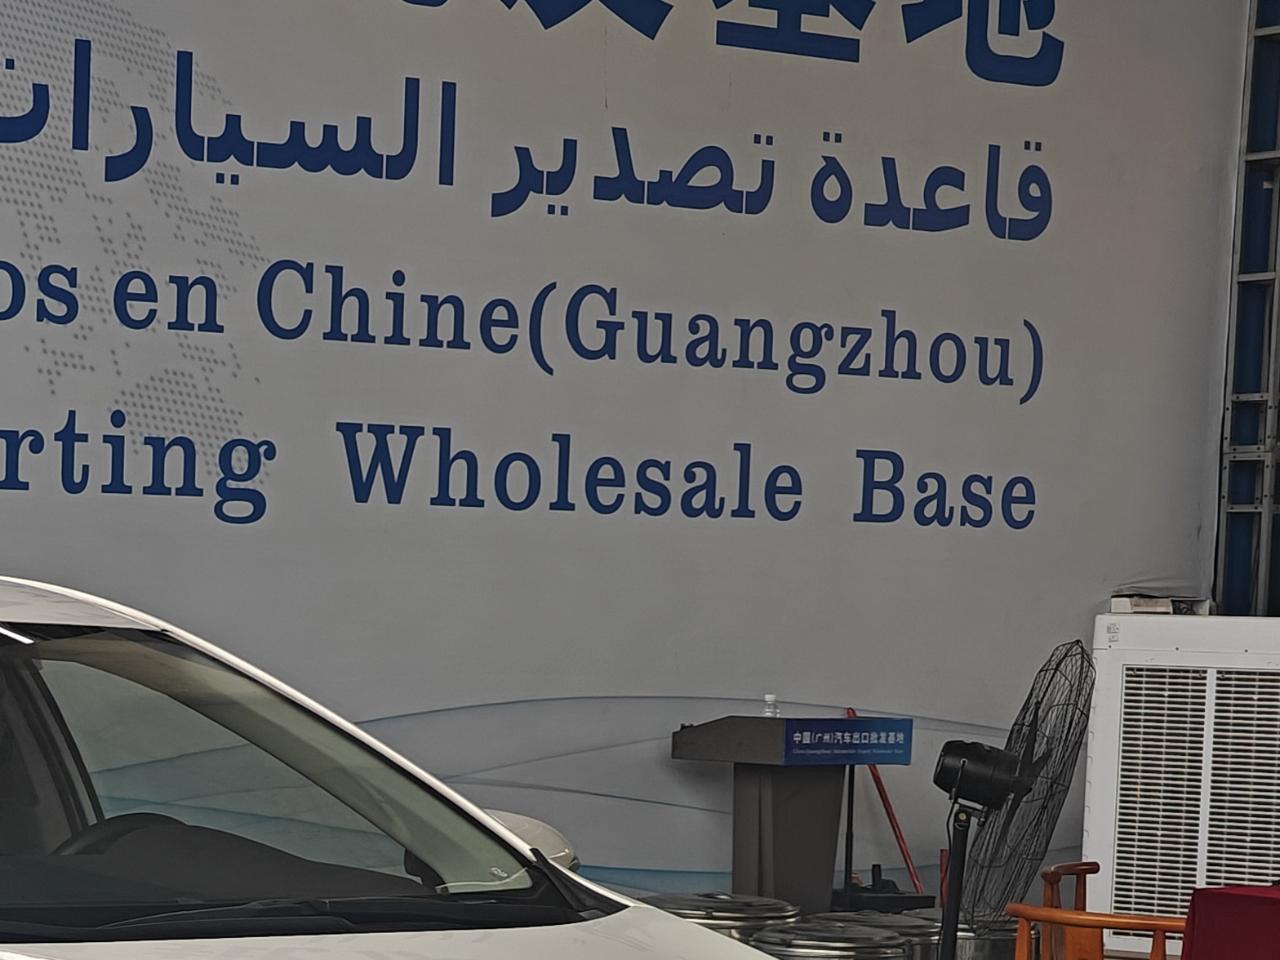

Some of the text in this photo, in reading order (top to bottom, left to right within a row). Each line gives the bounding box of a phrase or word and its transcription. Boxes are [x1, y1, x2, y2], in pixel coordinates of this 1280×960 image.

[491, 126, 776, 218] تصدير
[810, 132, 1055, 242] قاعدة
[113, 265, 225, 335] en
[256, 258, 1046, 405] Chine(Guangzhou)
[335, 422, 804, 521] Wholesale
[852, 448, 1038, 531] Base
